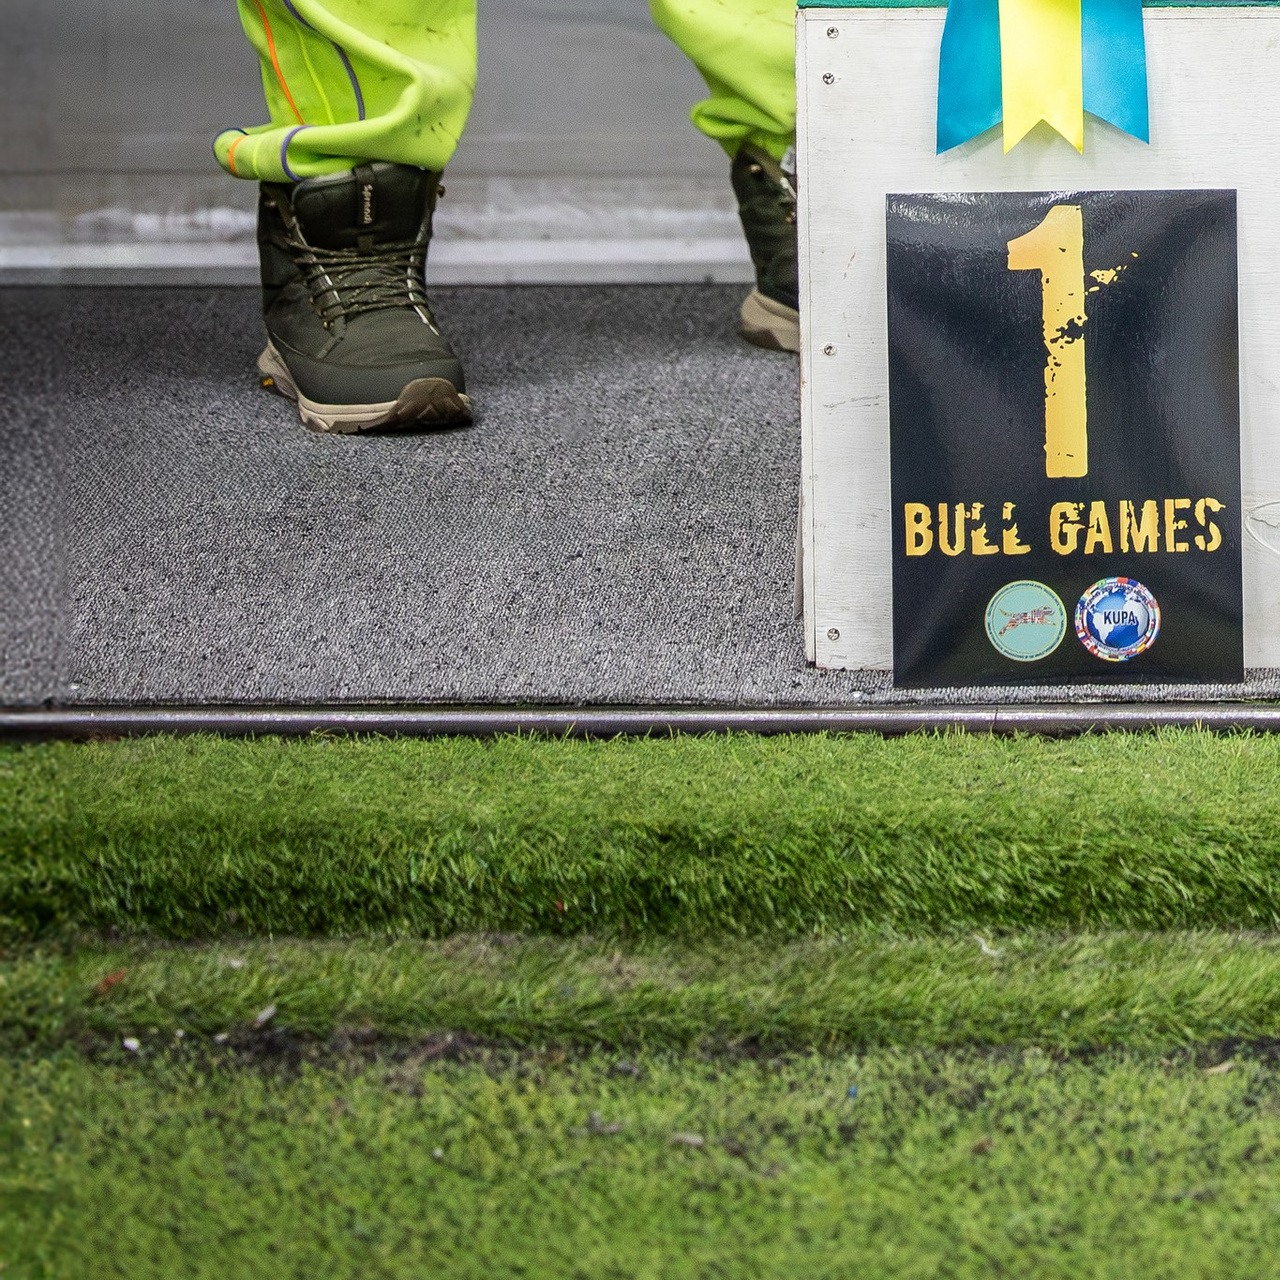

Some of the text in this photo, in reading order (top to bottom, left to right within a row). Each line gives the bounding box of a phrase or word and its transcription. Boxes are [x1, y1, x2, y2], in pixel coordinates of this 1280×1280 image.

[1006, 203, 1089, 479] 1
[904, 497, 1227, 557] BULL GAMES
[1102, 610, 1136, 626] KUPA
